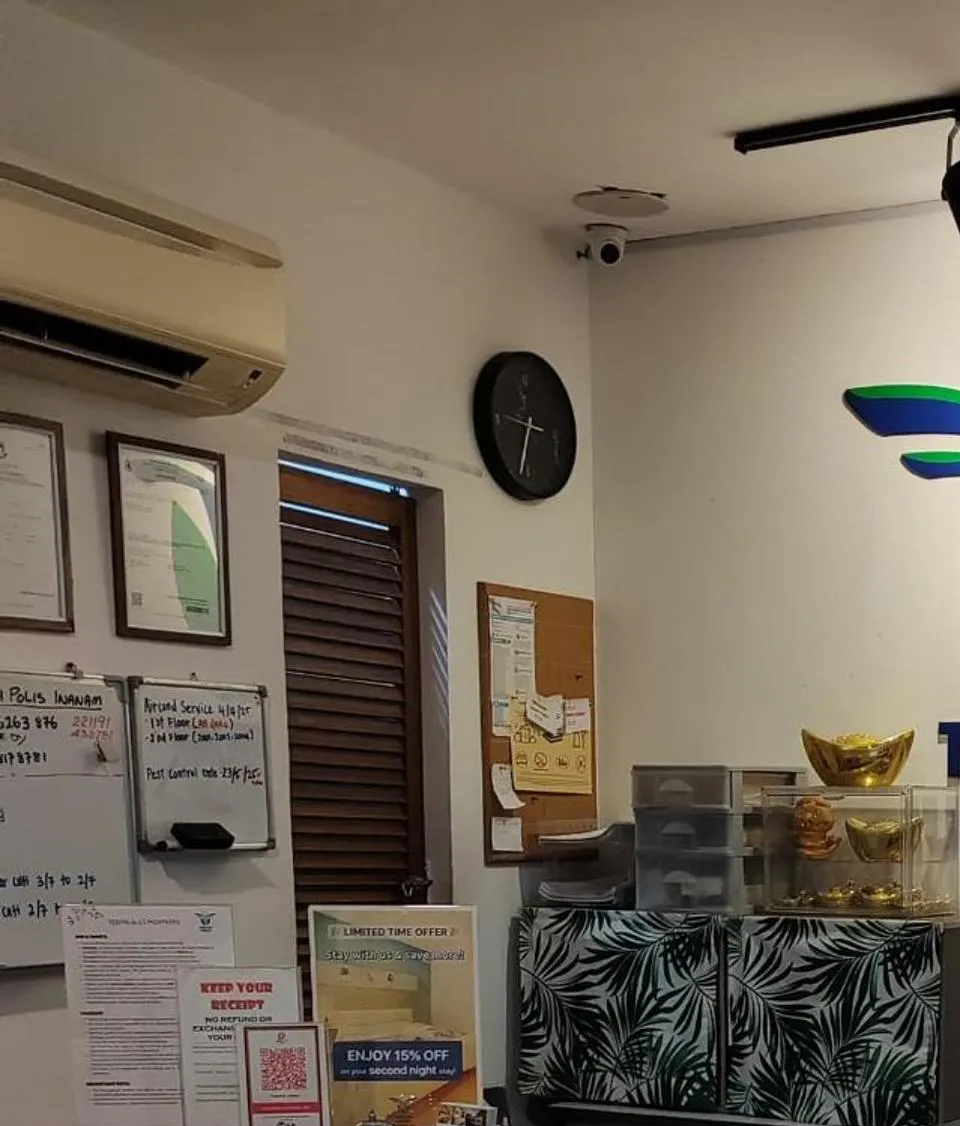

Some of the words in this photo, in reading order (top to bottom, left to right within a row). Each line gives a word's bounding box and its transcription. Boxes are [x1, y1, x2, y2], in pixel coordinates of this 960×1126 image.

[343, 927, 385, 937] LIMITED
[387, 927, 412, 937] TIME
[415, 927, 447, 937] OFFER
[352, 949, 376, 960] with
[200, 982, 234, 993] KEEP
[236, 982, 272, 993] YOUR
[211, 999, 264, 1010] RECEIPT
[347, 1050, 393, 1061] ENJOY
[395, 1049, 421, 1061] 15%
[423, 1049, 449, 1061] OFF
[368, 1066, 407, 1075] second
[409, 1065, 437, 1077] night
